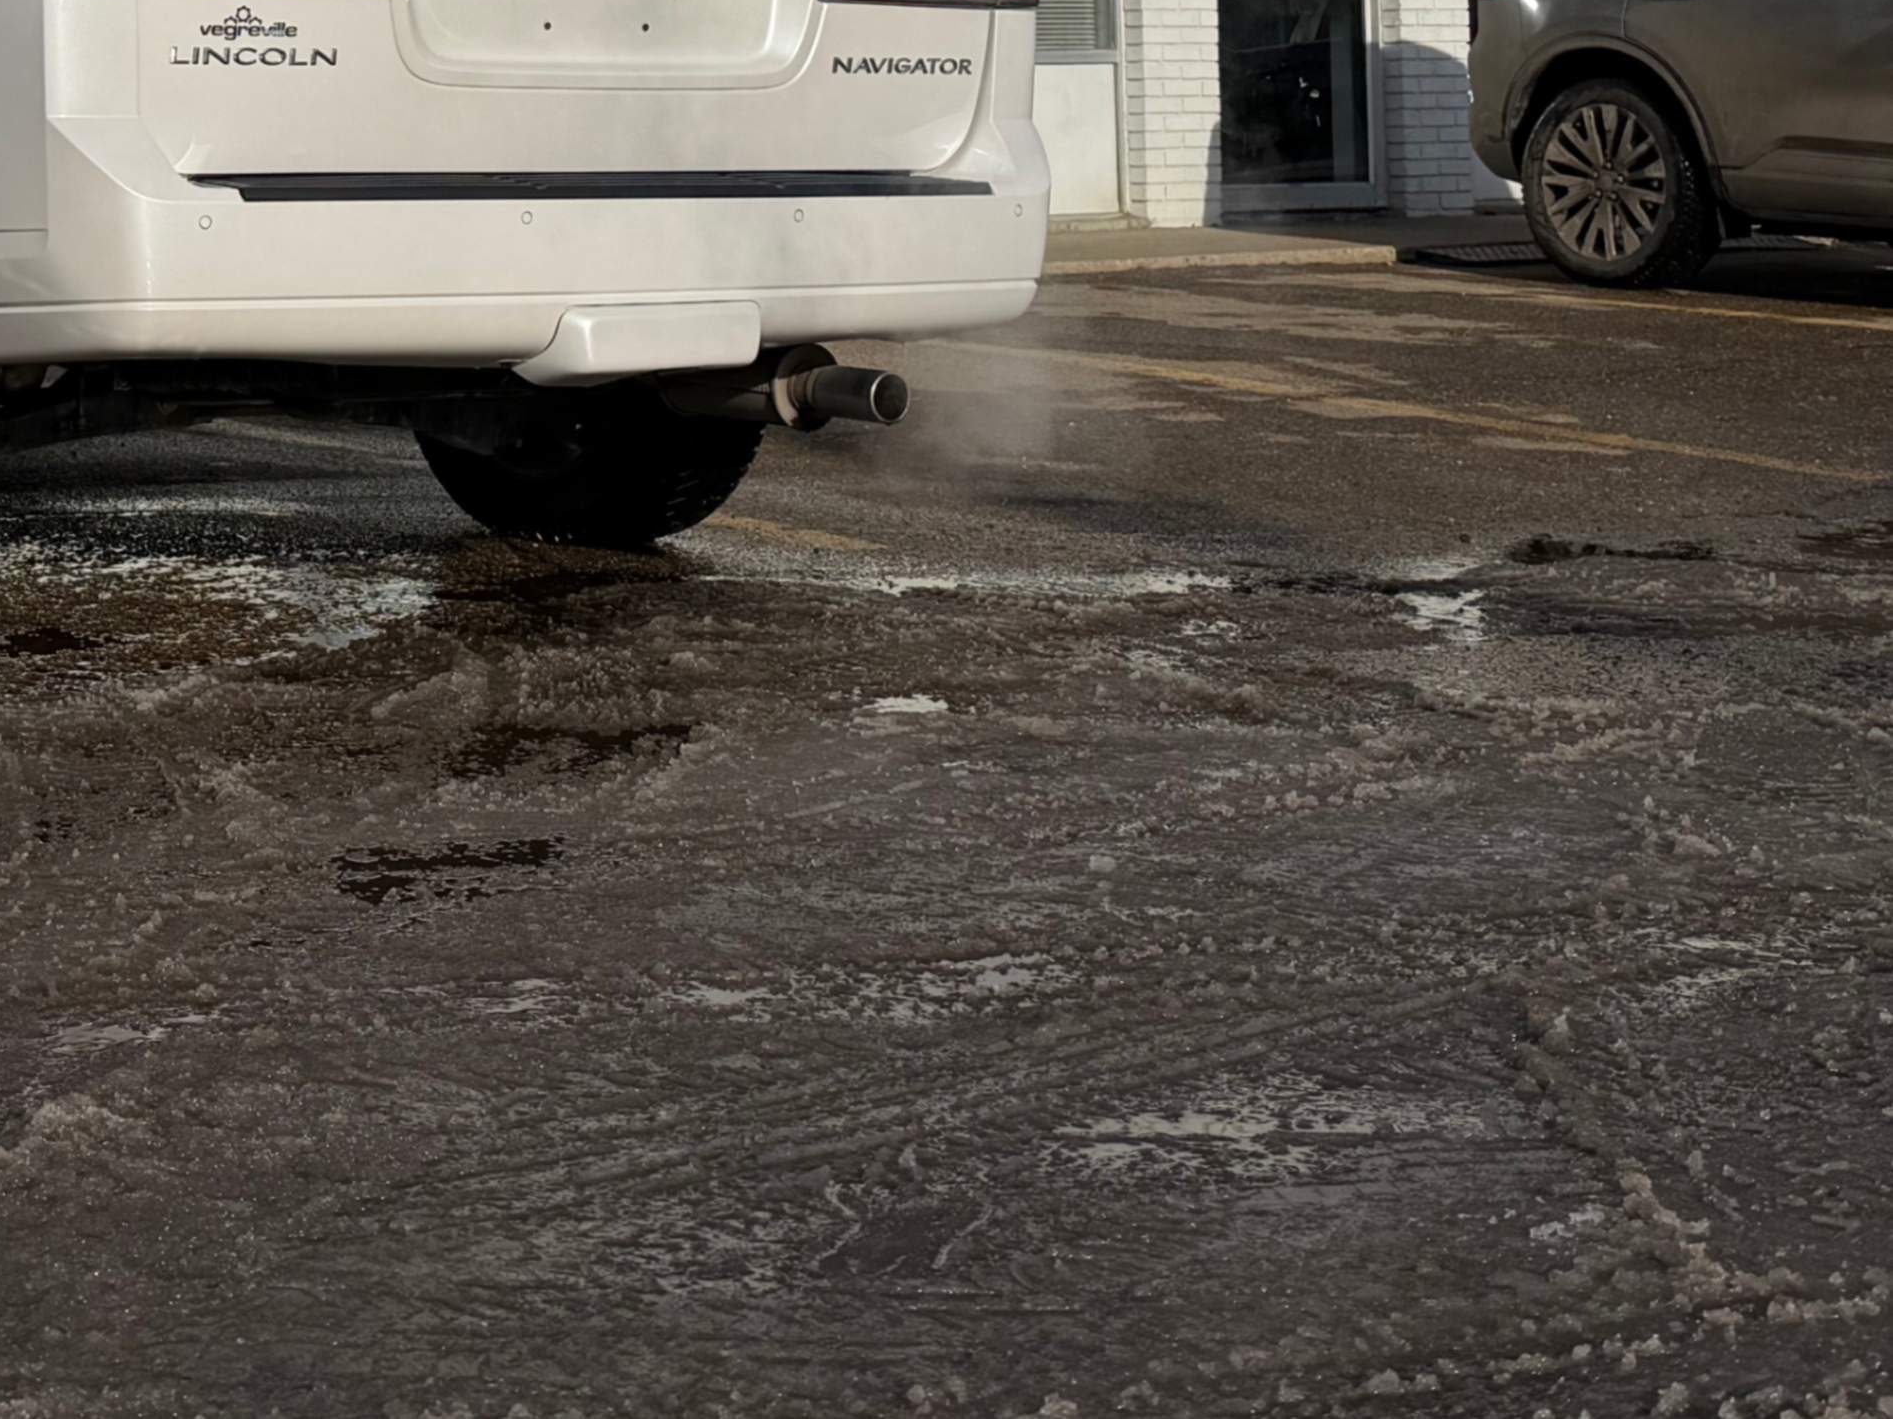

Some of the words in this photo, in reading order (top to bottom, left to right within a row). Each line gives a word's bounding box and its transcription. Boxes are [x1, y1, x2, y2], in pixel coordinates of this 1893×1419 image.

[200, 22, 298, 41] vegreville
[170, 46, 338, 66] LINCOLN
[832, 56, 972, 75] NAVIGATOR
